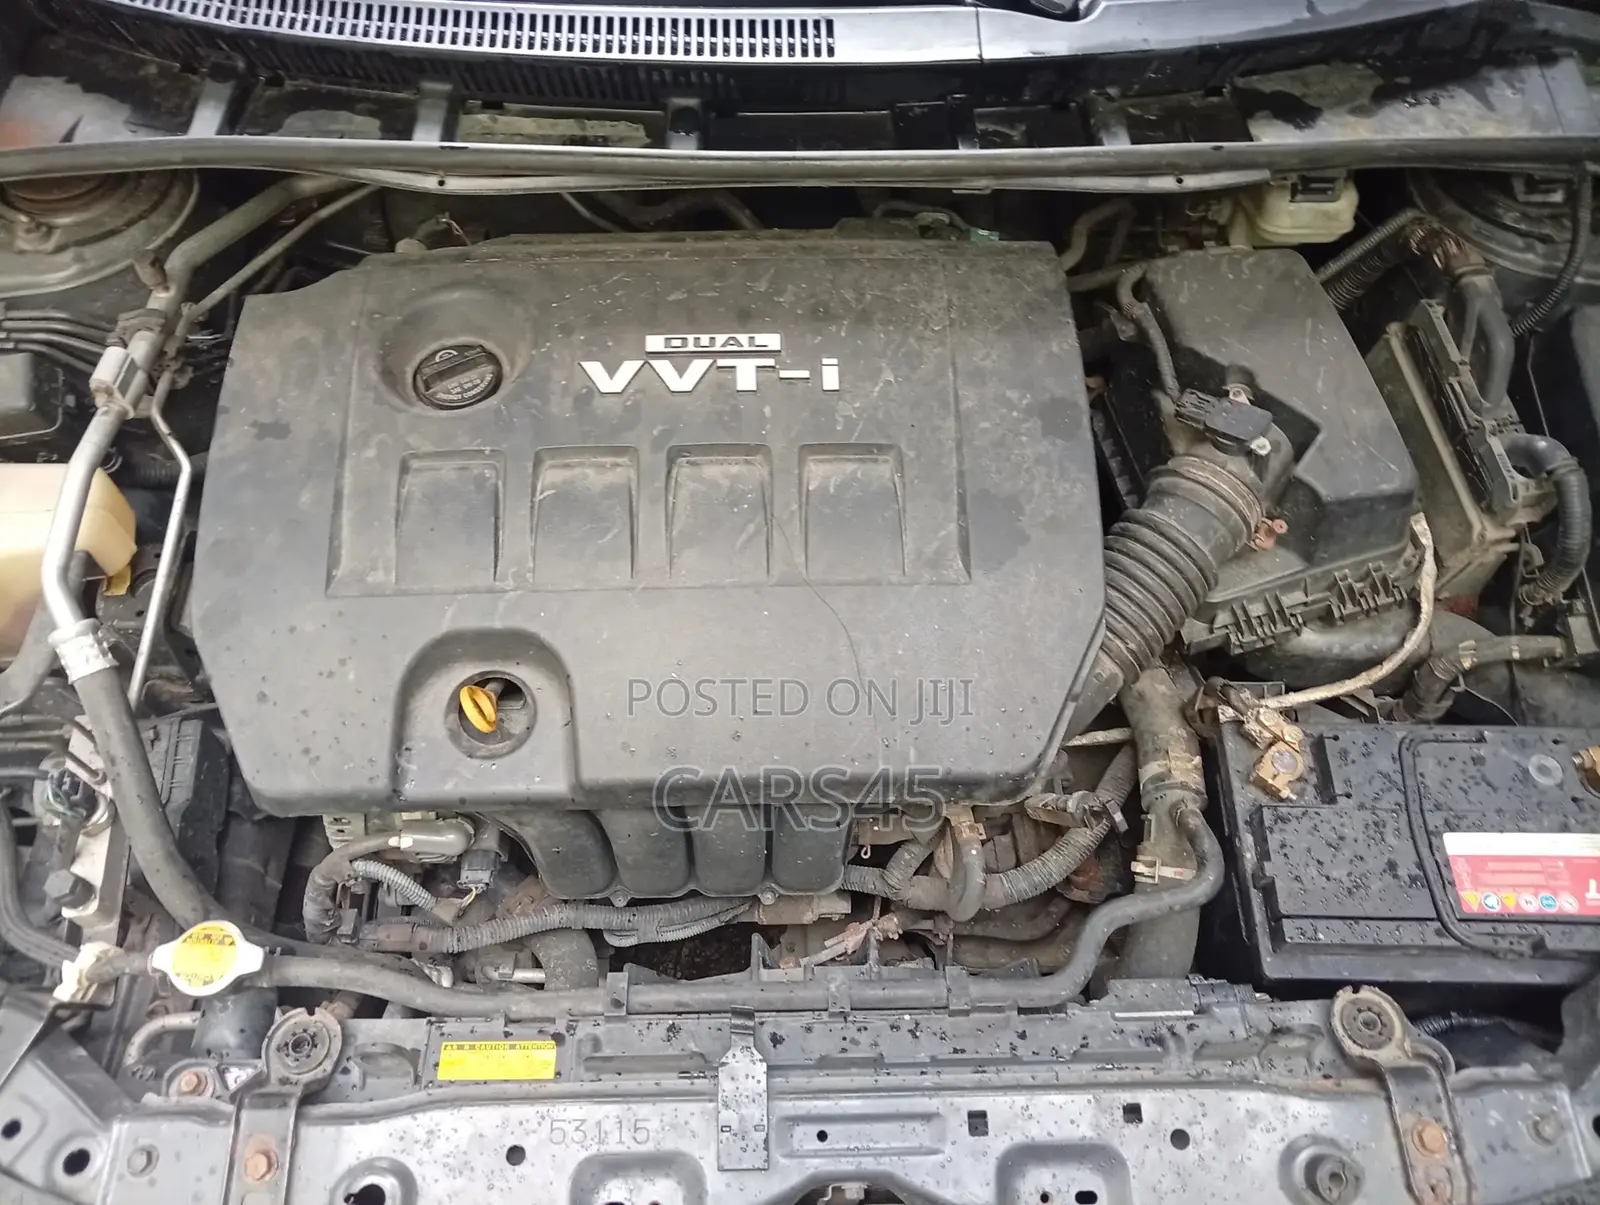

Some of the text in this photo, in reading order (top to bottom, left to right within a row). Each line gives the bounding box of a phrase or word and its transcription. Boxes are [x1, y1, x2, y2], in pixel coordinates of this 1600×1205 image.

[663, 337, 769, 348] DUAL
[579, 358, 839, 393] VVT-i
[550, 1118, 650, 1145] 53115
